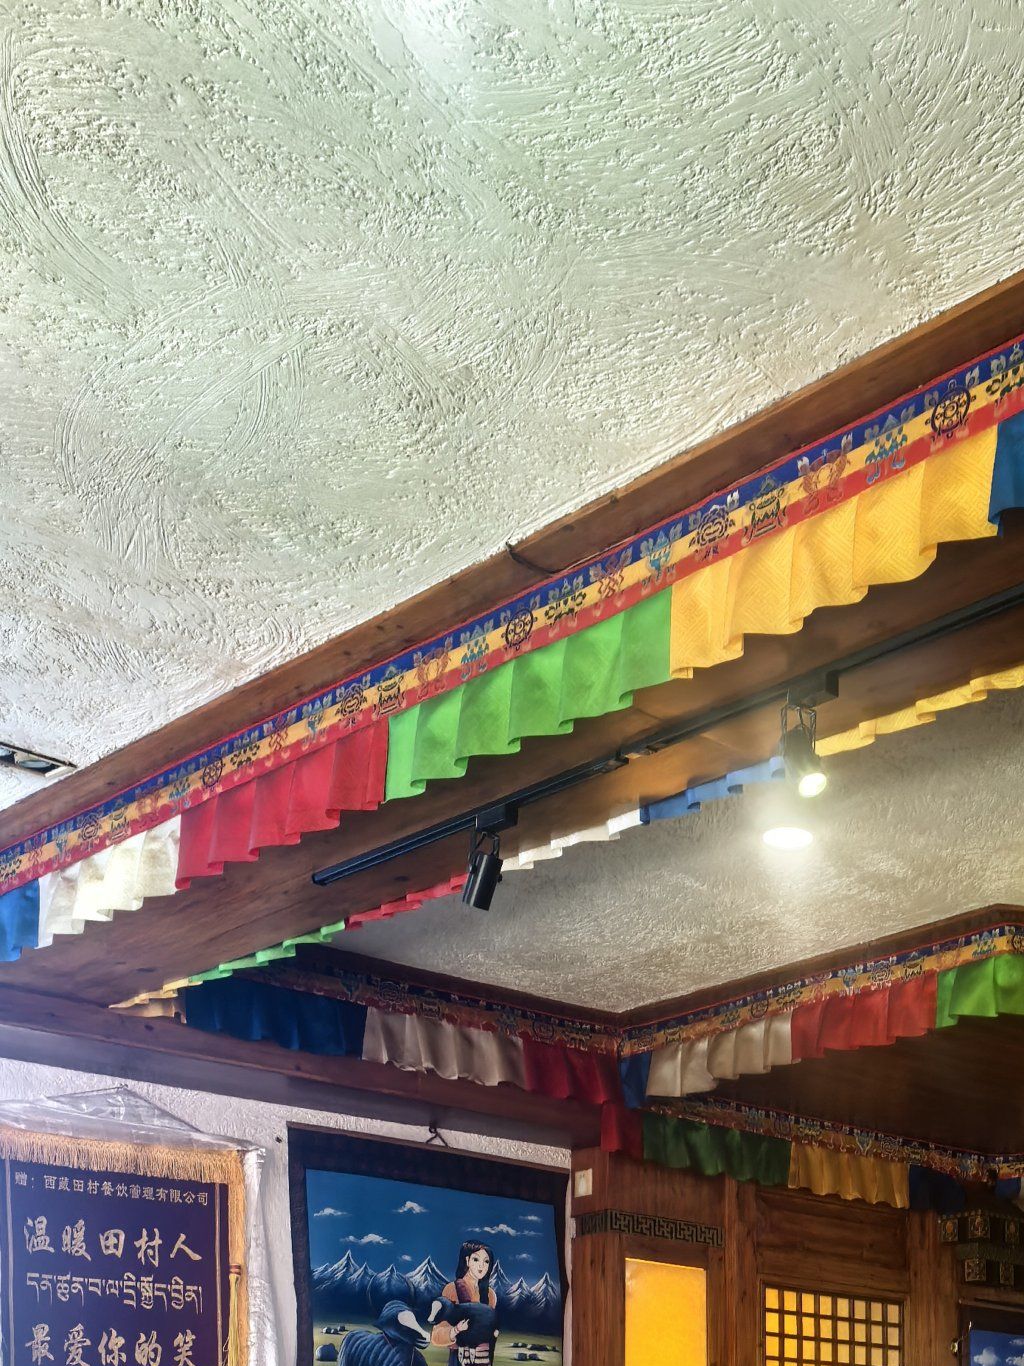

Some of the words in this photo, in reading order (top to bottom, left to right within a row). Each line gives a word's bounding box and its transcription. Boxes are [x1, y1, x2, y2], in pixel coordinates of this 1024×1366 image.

[23, 1215, 203, 1268] 温暖田村人
